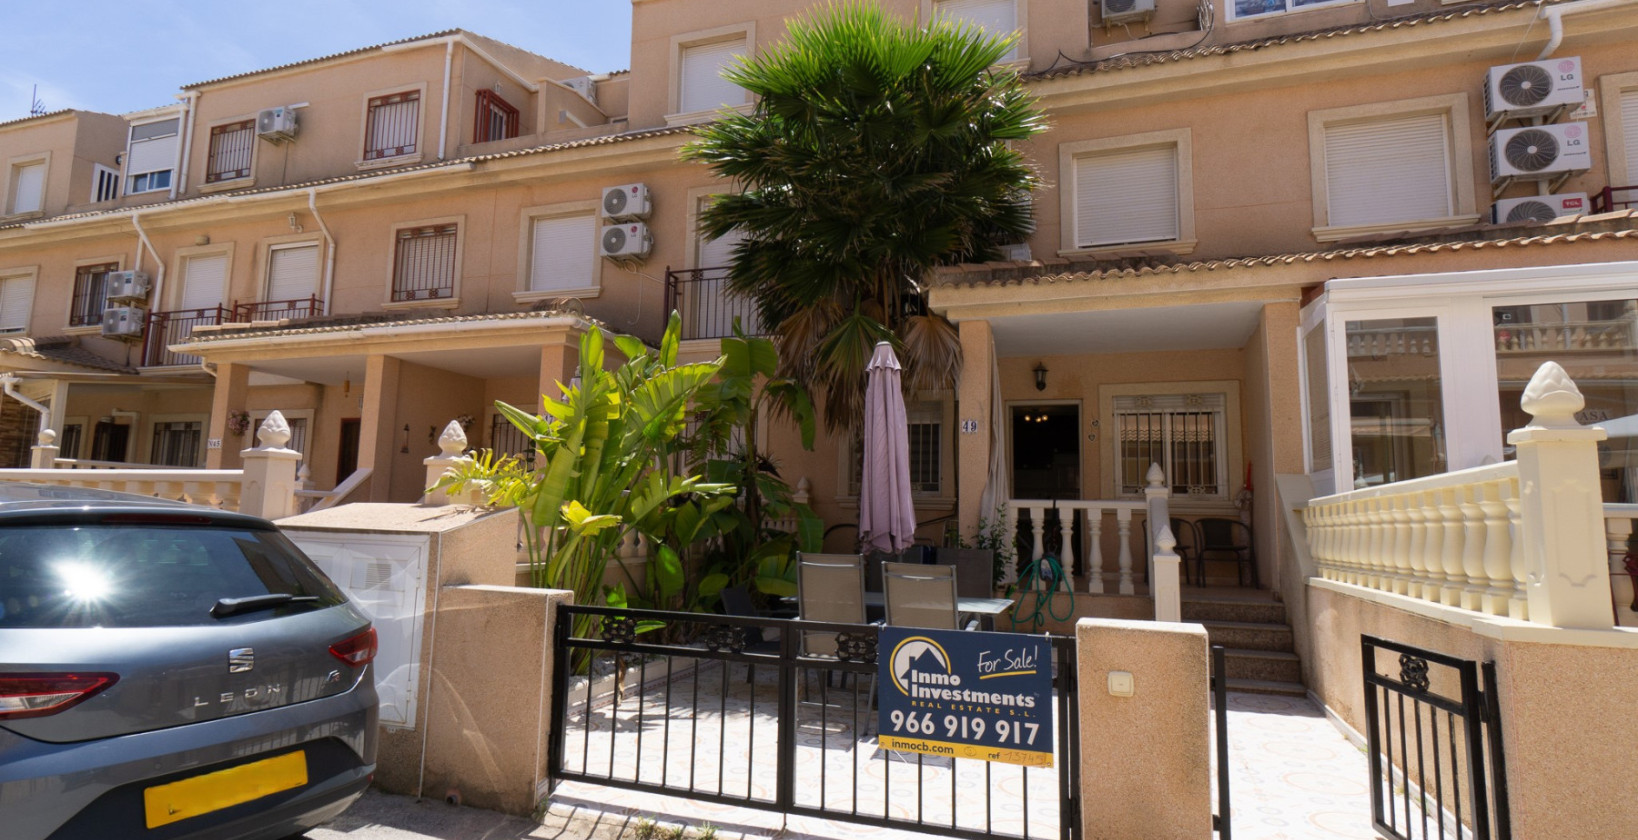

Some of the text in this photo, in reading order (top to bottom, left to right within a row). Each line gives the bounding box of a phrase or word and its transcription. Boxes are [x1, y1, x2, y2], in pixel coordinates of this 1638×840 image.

[1560, 73, 1574, 81] LG
[1567, 139, 1581, 147] LG
[962, 420, 977, 432] 49
[977, 645, 1038, 673] For Sale!
[911, 669, 961, 686] Inmo
[194, 683, 281, 707] LEON
[911, 684, 1036, 708] Investments
[911, 700, 1037, 718] REAL ESTATE S.L.
[890, 709, 1040, 746] 966 919 917
[891, 738, 954, 754] inmocb.com
[988, 751, 1001, 759] ref
